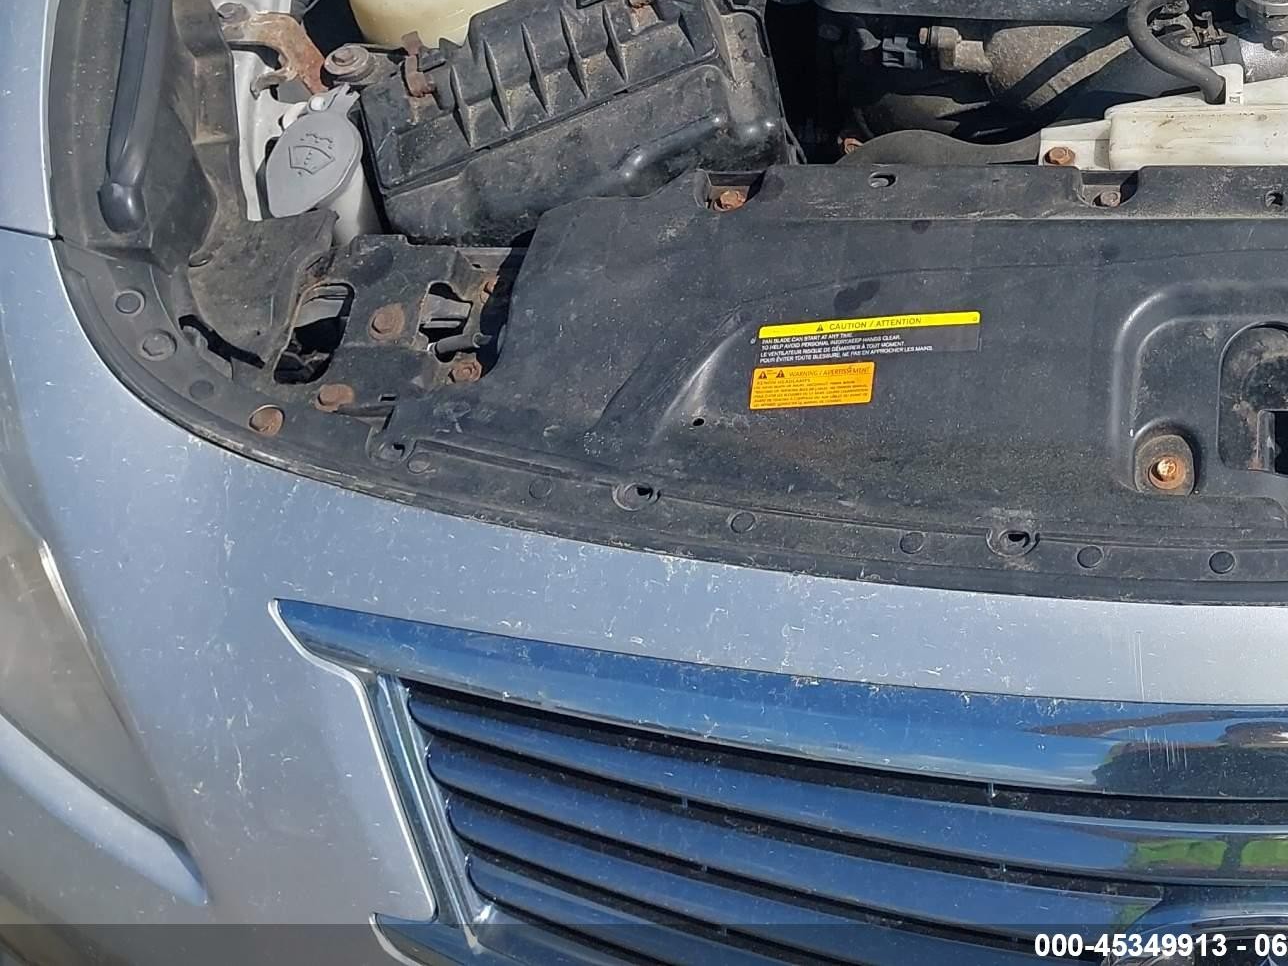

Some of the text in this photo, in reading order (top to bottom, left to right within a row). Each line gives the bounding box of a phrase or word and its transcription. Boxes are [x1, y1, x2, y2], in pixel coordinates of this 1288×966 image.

[829, 321, 867, 331] CAUTION
[876, 317, 922, 327] ATTENTION
[801, 340, 829, 348] PERSONAL
[767, 348, 802, 357] VENTILATEUR
[802, 346, 823, 354] RISQUE
[776, 354, 794, 363] ÉVITER
[870, 347, 904, 355] APPROCHER
